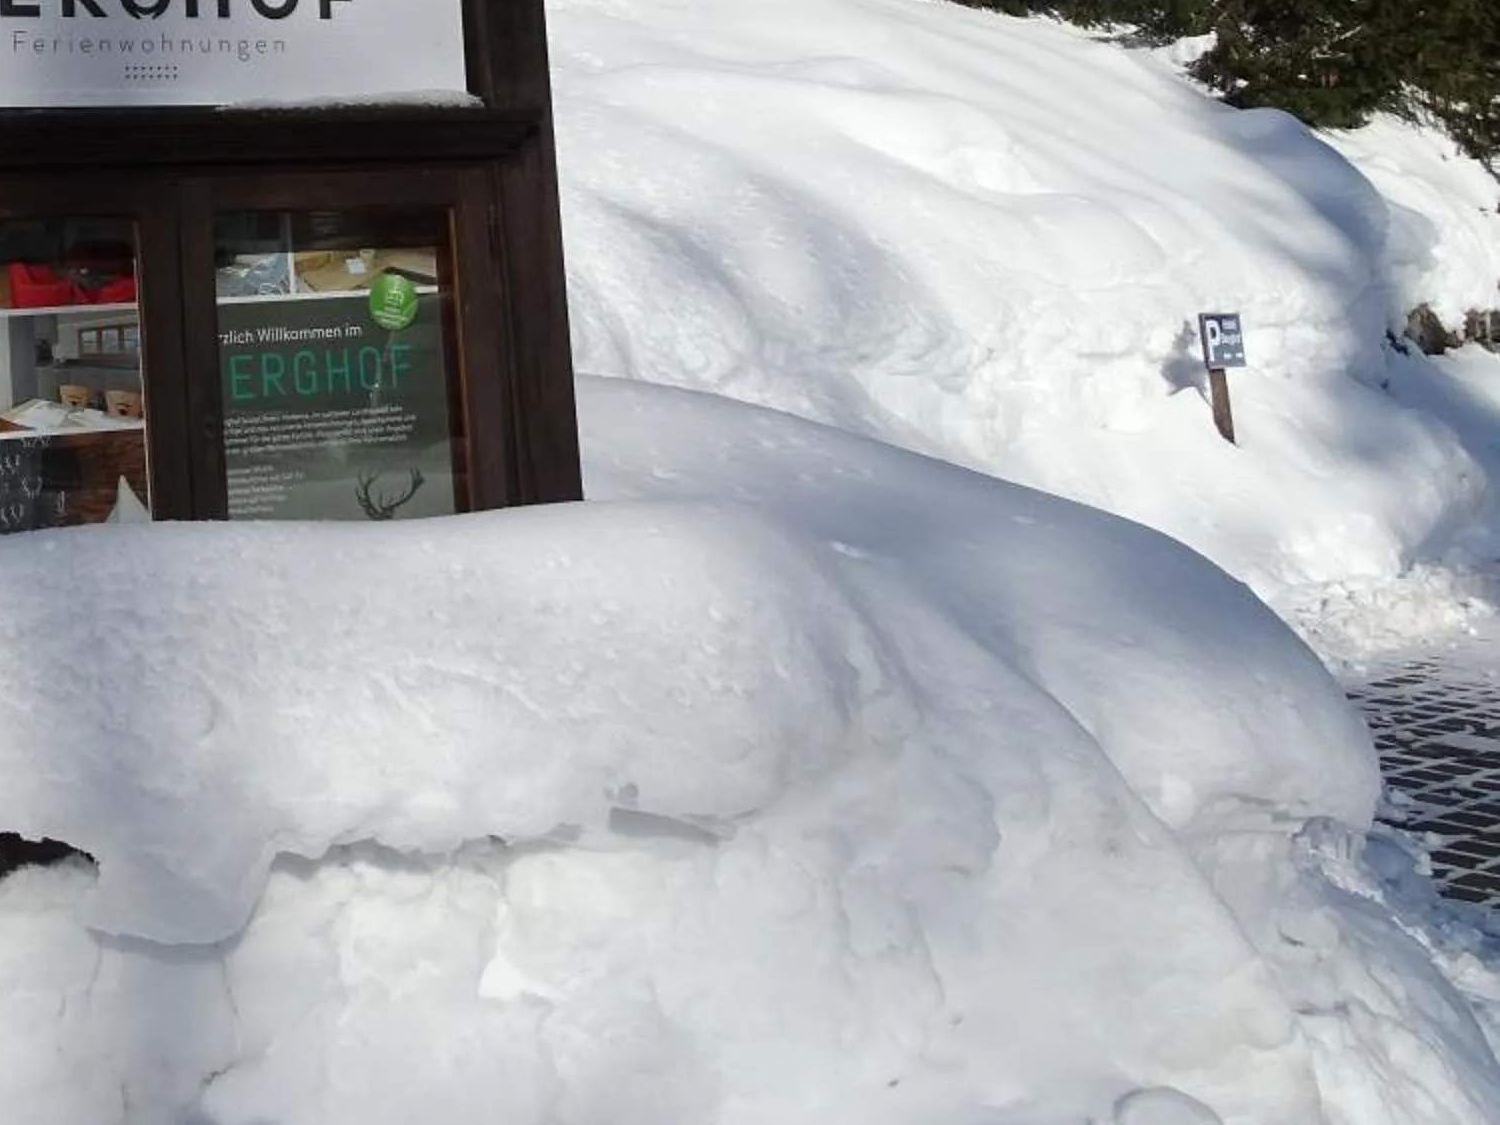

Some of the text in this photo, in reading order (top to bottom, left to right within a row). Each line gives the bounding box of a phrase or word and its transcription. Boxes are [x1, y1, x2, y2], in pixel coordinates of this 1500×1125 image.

[11, 30, 286, 62] Ferienwohnungen
[256, 325, 341, 343] Willkommen
[345, 322, 363, 337] im
[1205, 320, 1221, 362] P
